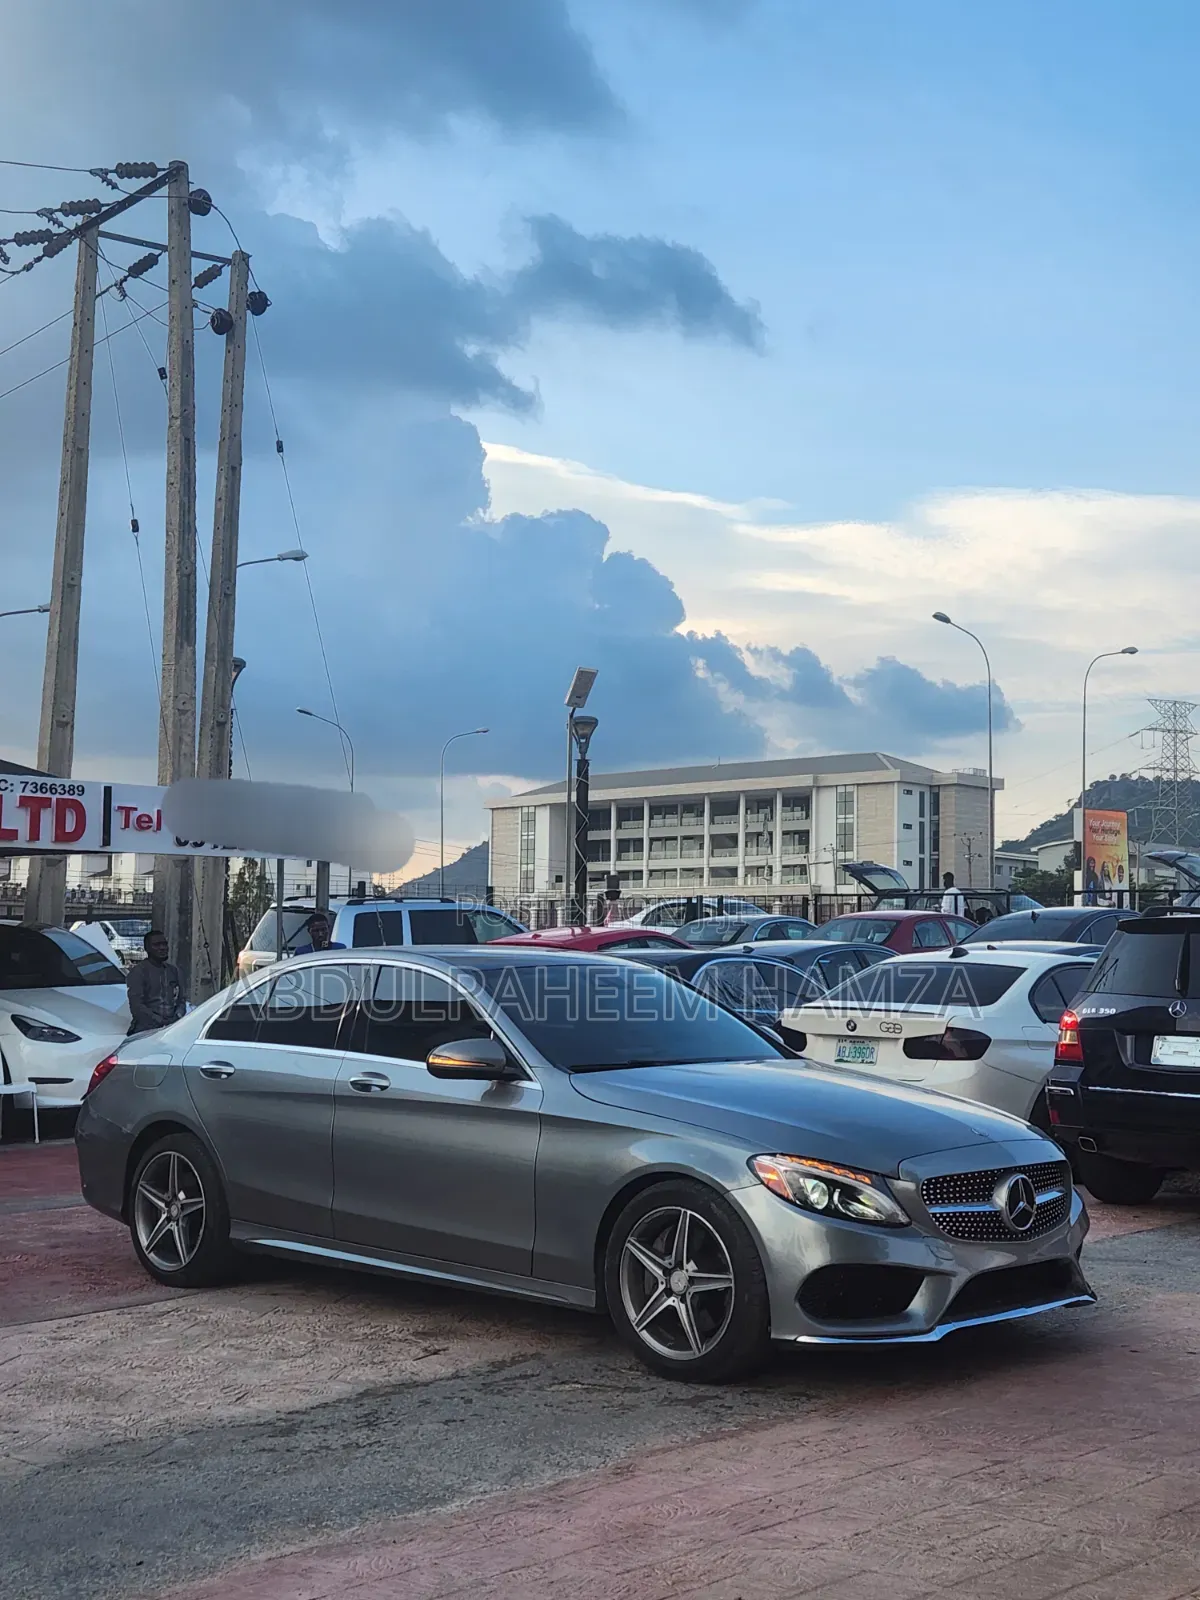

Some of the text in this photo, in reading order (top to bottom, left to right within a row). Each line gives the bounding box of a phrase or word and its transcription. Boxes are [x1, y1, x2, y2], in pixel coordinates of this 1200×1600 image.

[20, 781, 85, 797] 7366389
[0, 793, 87, 843] LTD
[1098, 1007, 1116, 1015] 350
